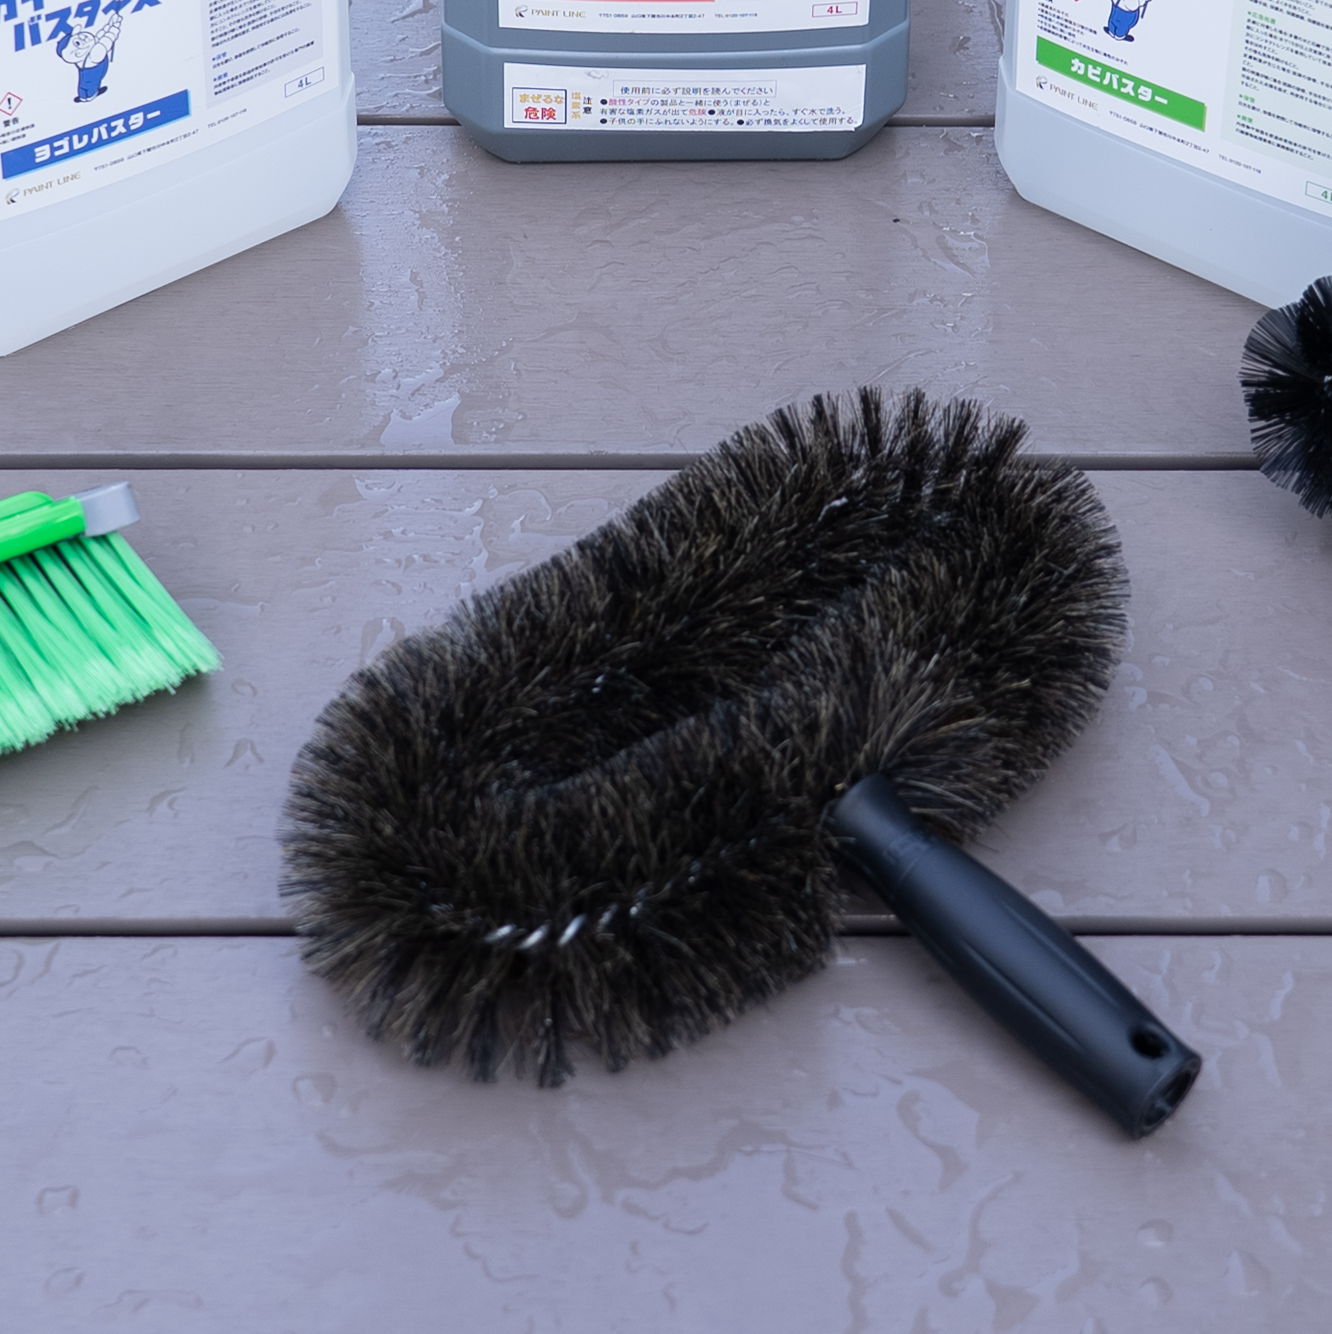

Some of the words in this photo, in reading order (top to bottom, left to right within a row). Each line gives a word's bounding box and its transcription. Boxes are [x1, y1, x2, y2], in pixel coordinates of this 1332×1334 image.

[827, 5, 842, 14] 4L
[297, 77, 312, 88] 4L
[1070, 56, 1168, 107] カビバスター
[519, 93, 564, 104] まぜるな
[524, 107, 556, 121] 危険
[34, 109, 161, 165] ヨゴレバスター
